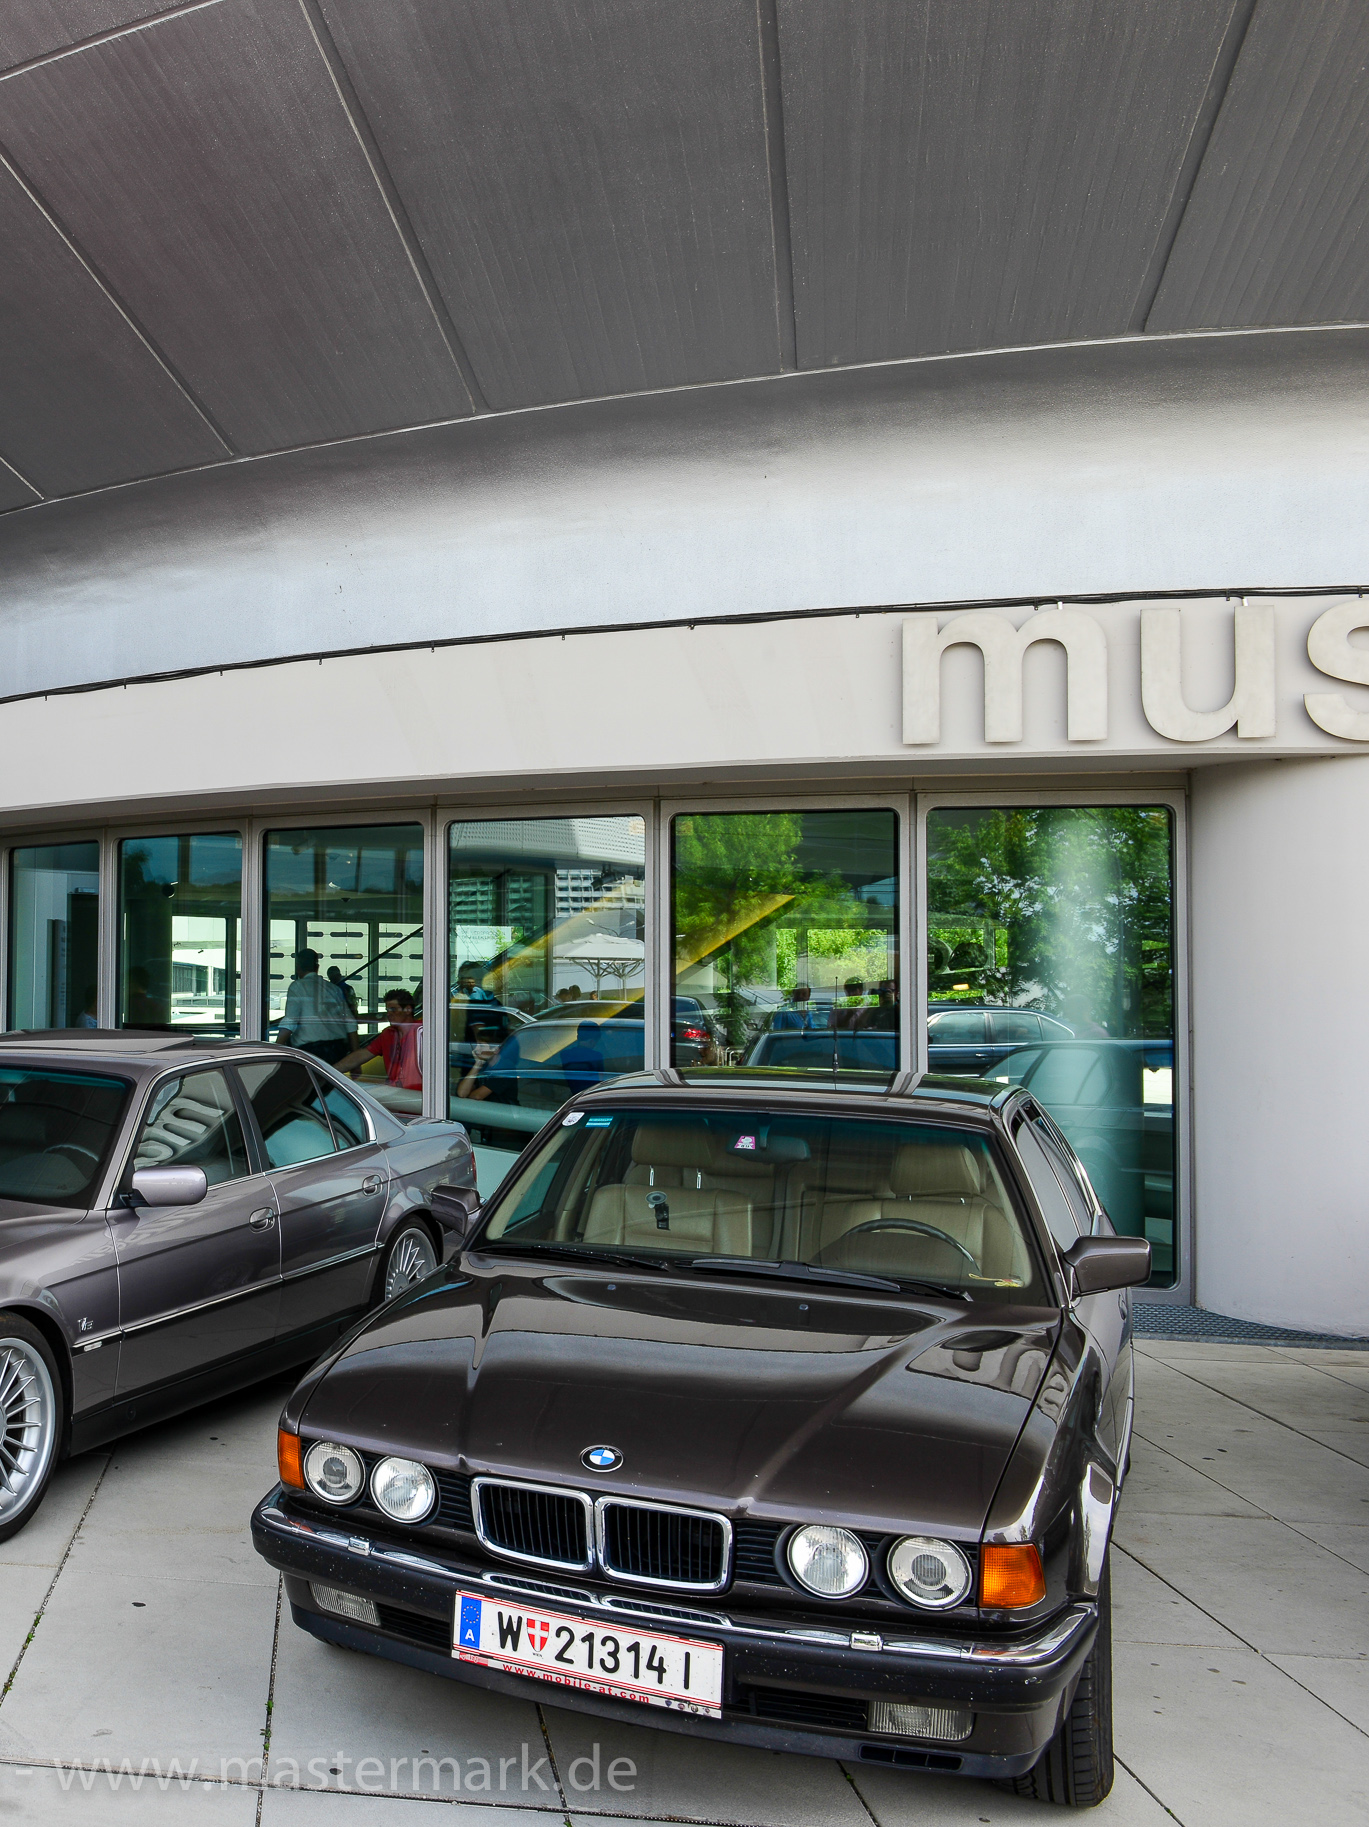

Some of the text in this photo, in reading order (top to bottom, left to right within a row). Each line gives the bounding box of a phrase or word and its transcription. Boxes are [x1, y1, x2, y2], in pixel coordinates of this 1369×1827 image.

[902, 600, 1369, 744] mus
[464, 1628, 475, 1642] A
[497, 1610, 522, 1652] W
[554, 1625, 667, 1684] 21314
[502, 1662, 650, 1704] www.mobile-at.com
